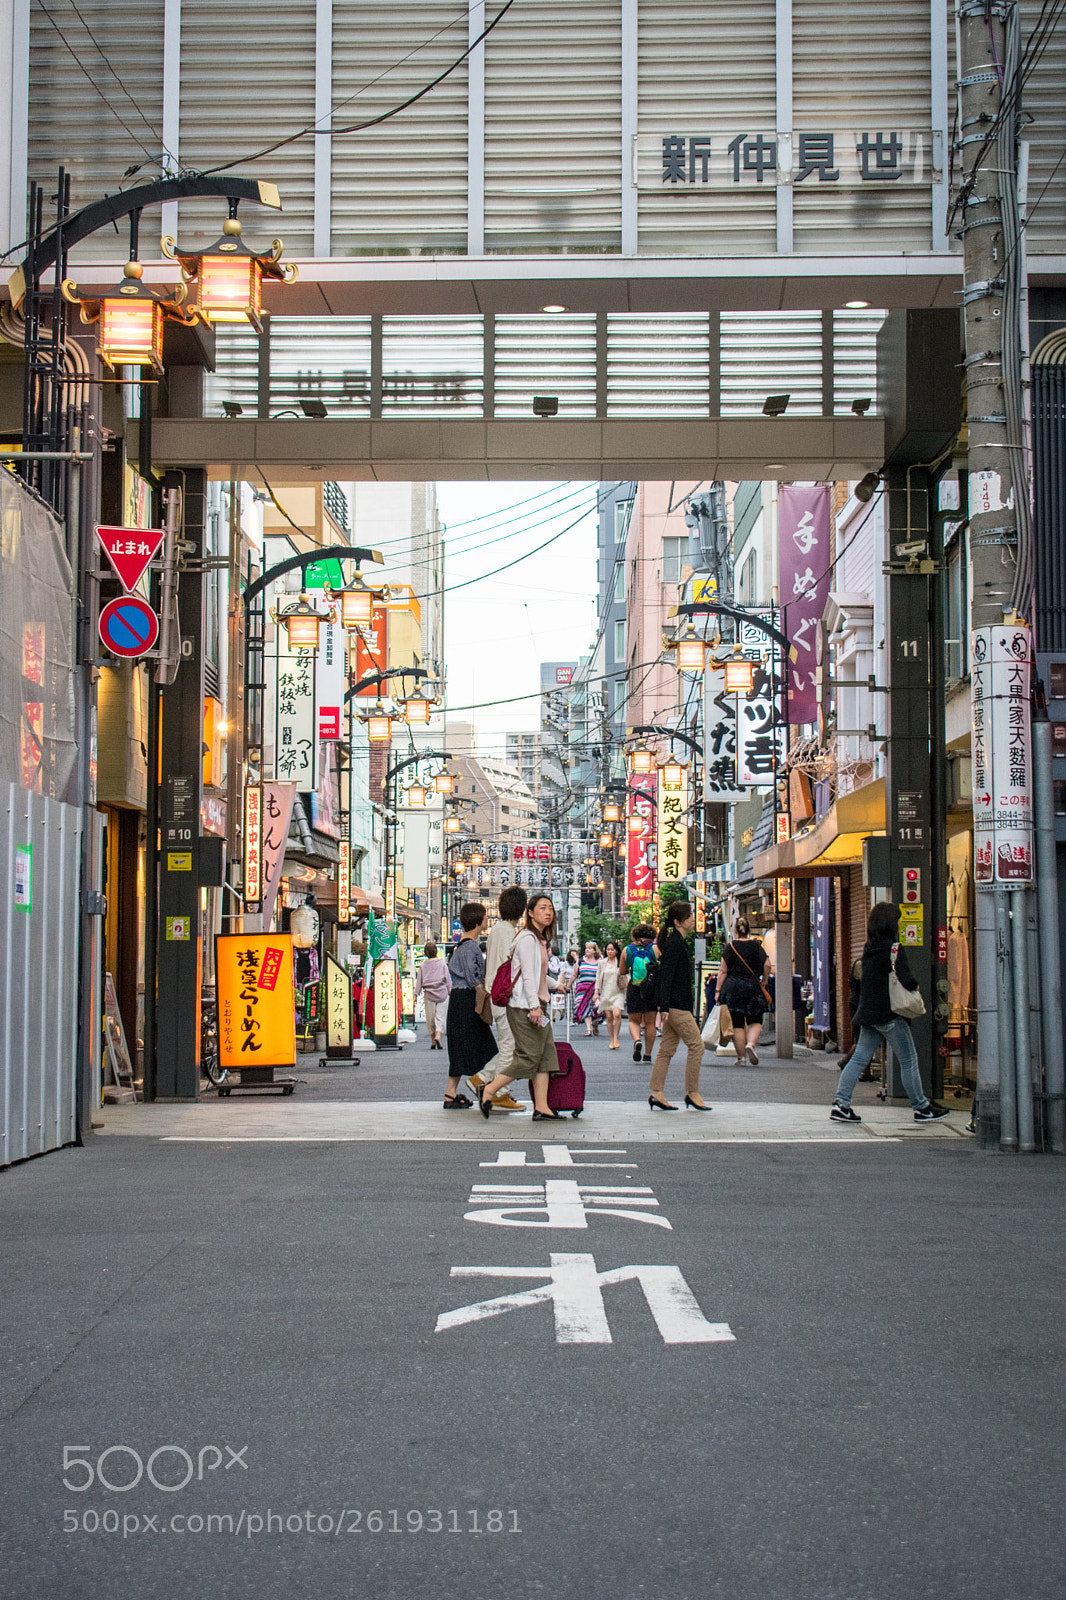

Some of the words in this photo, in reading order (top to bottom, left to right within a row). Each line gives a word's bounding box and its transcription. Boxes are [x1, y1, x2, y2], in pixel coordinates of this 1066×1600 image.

[662, 133, 904, 184] 新仲見世
[110, 539, 152, 556] 止まれ
[792, 511, 818, 692] 手ぬぐい
[900, 640, 918, 657] 11
[278, 672, 297, 716] 鉄板焼
[177, 828, 192, 840] 10
[247, 792, 259, 897] 浅草中央通り
[264, 793, 282, 899] もんじ
[899, 828, 911, 840] 11
[937, 929, 947, 958] 送水口
[236, 949, 262, 1052] 浅草らーめん
[332, 972, 346, 1046] お好み焼き
[433, 1144, 738, 1344] 止まれ
